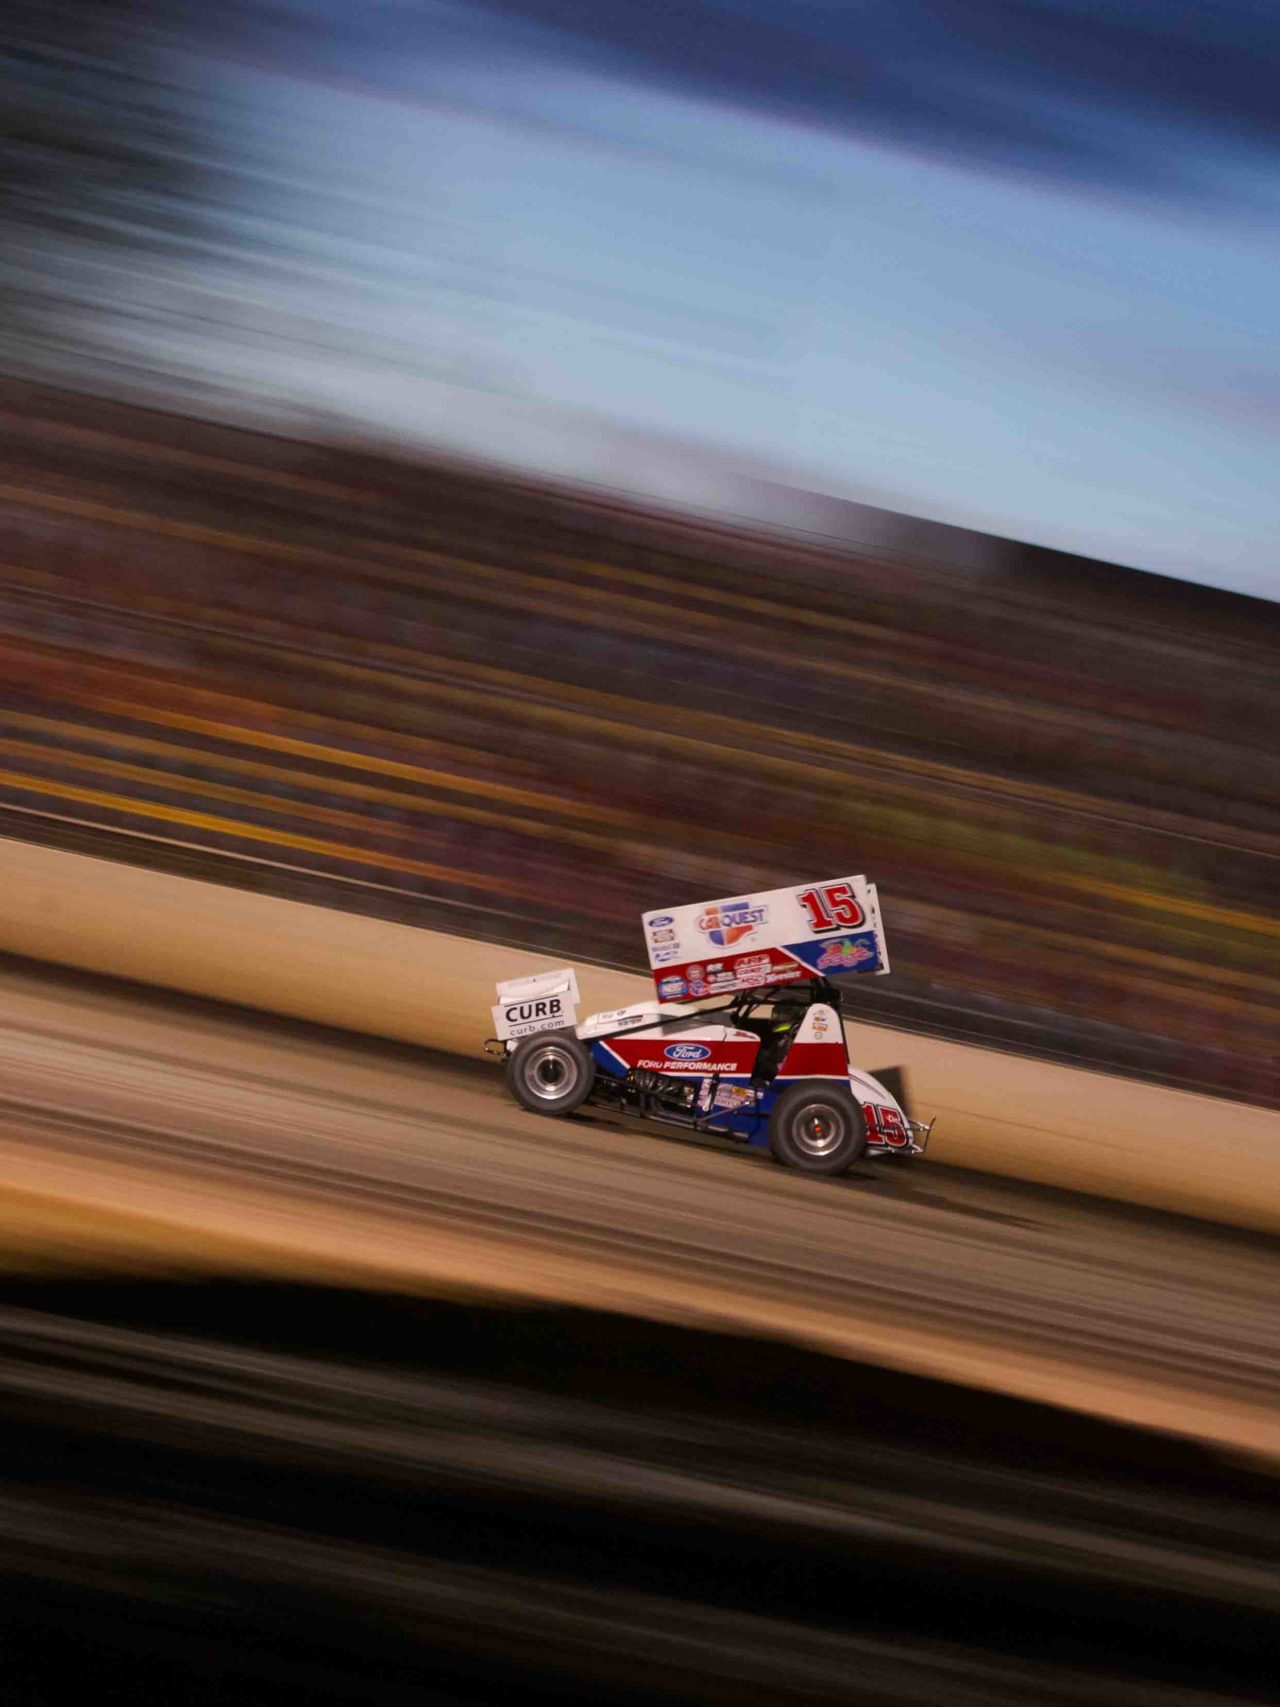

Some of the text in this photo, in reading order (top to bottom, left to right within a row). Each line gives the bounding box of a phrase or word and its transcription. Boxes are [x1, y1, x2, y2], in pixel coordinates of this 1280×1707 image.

[797, 883, 866, 934] 15
[505, 998, 562, 1023] CURB
[509, 1018, 565, 1037] curb.com
[672, 1045, 703, 1059] Ford
[663, 1061, 738, 1072] PERFORMANCE
[861, 1102, 908, 1149] 15
